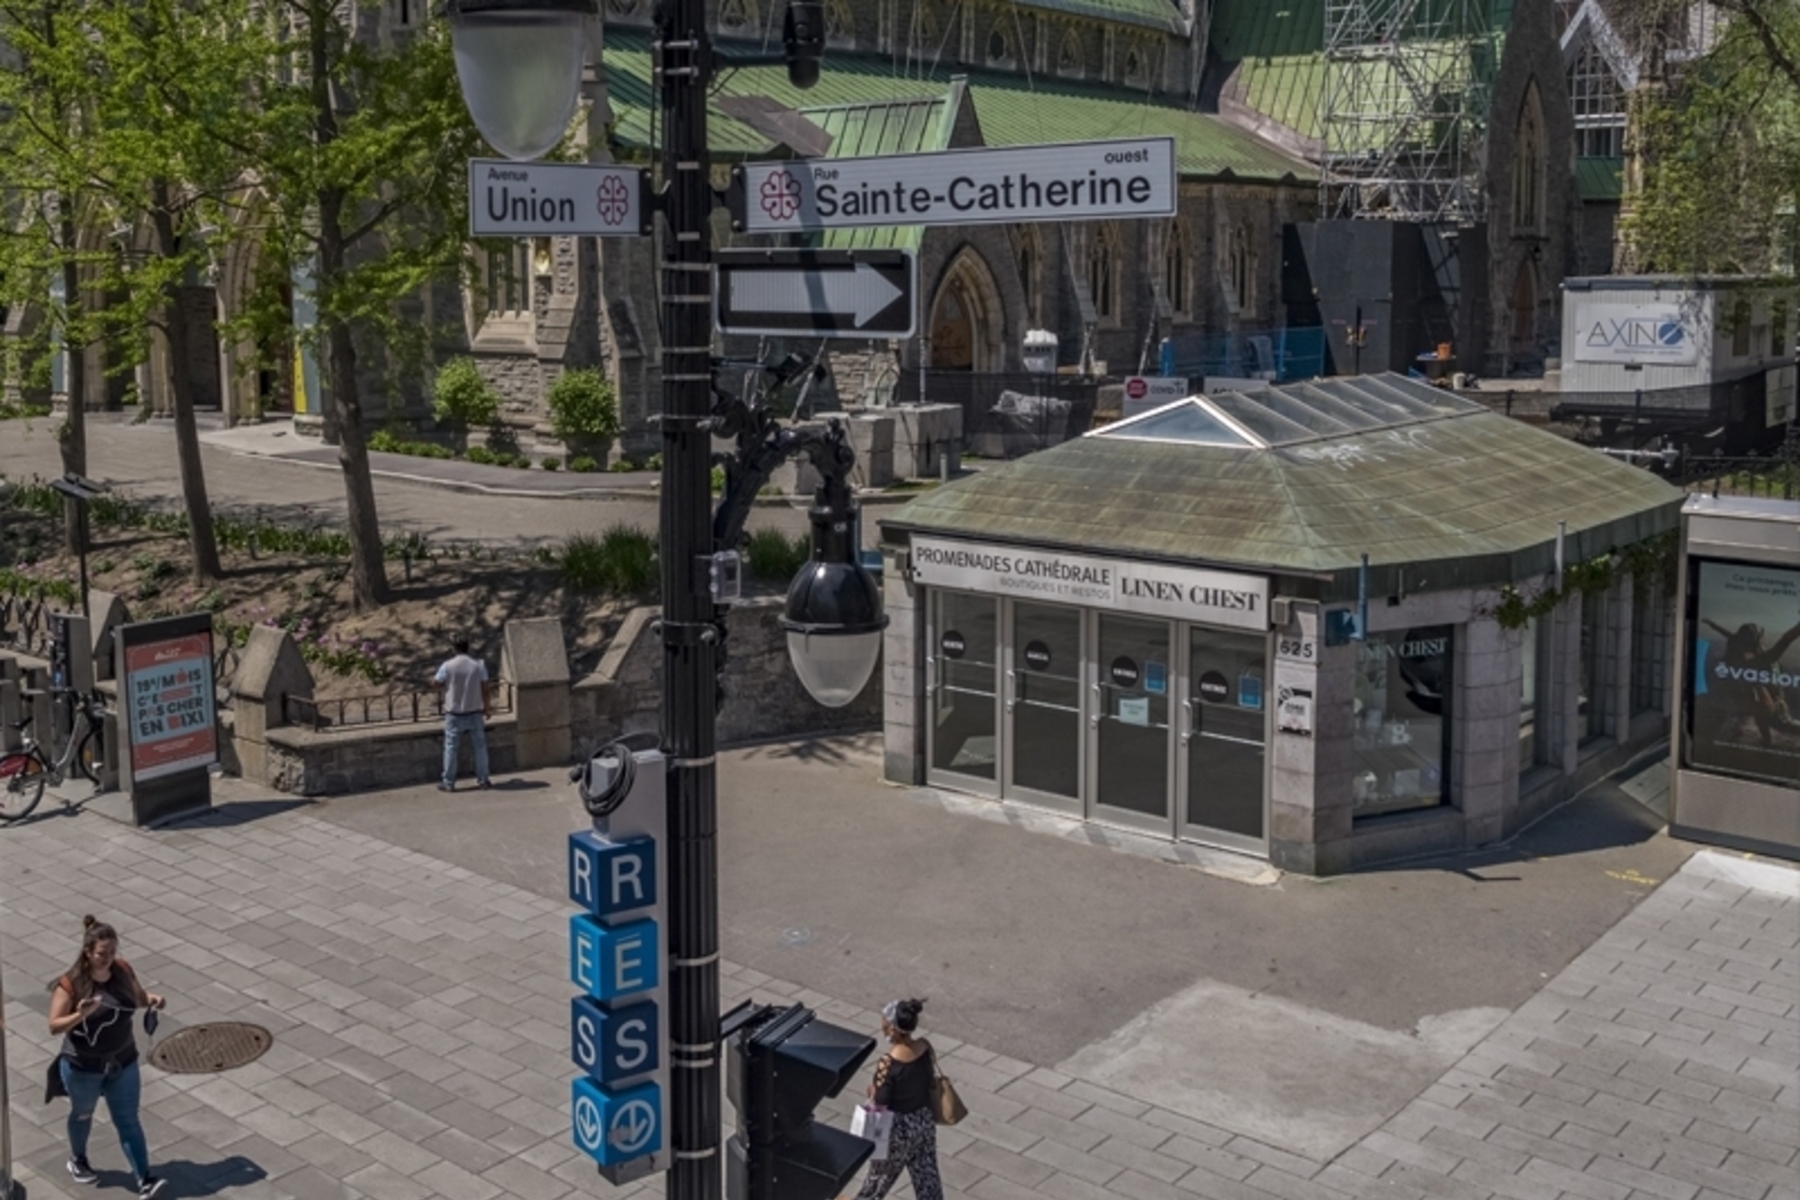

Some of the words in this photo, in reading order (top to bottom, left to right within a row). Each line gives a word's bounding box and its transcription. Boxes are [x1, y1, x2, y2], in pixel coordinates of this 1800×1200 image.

[1104, 149, 1149, 164] ouest
[488, 167, 529, 182] Avenue
[814, 168, 839, 180] Rue
[815, 170, 1150, 217] Sainte-Catherine
[487, 186, 575, 222] Union
[916, 546, 1011, 573] PROMENADES
[1014, 557, 1111, 586] CATHÉDRALE
[999, 576, 1056, 593] BOUTIQUES
[1057, 584, 1070, 595] ET
[1071, 586, 1111, 600] RESTOS
[1120, 577, 1183, 602] LINEN
[1189, 585, 1260, 611] CHEST
[1280, 640, 1313, 657] 625
[1399, 638, 1447, 658] CHEST
[166, 698, 204, 715] CHER
[139, 720, 164, 737] EN
